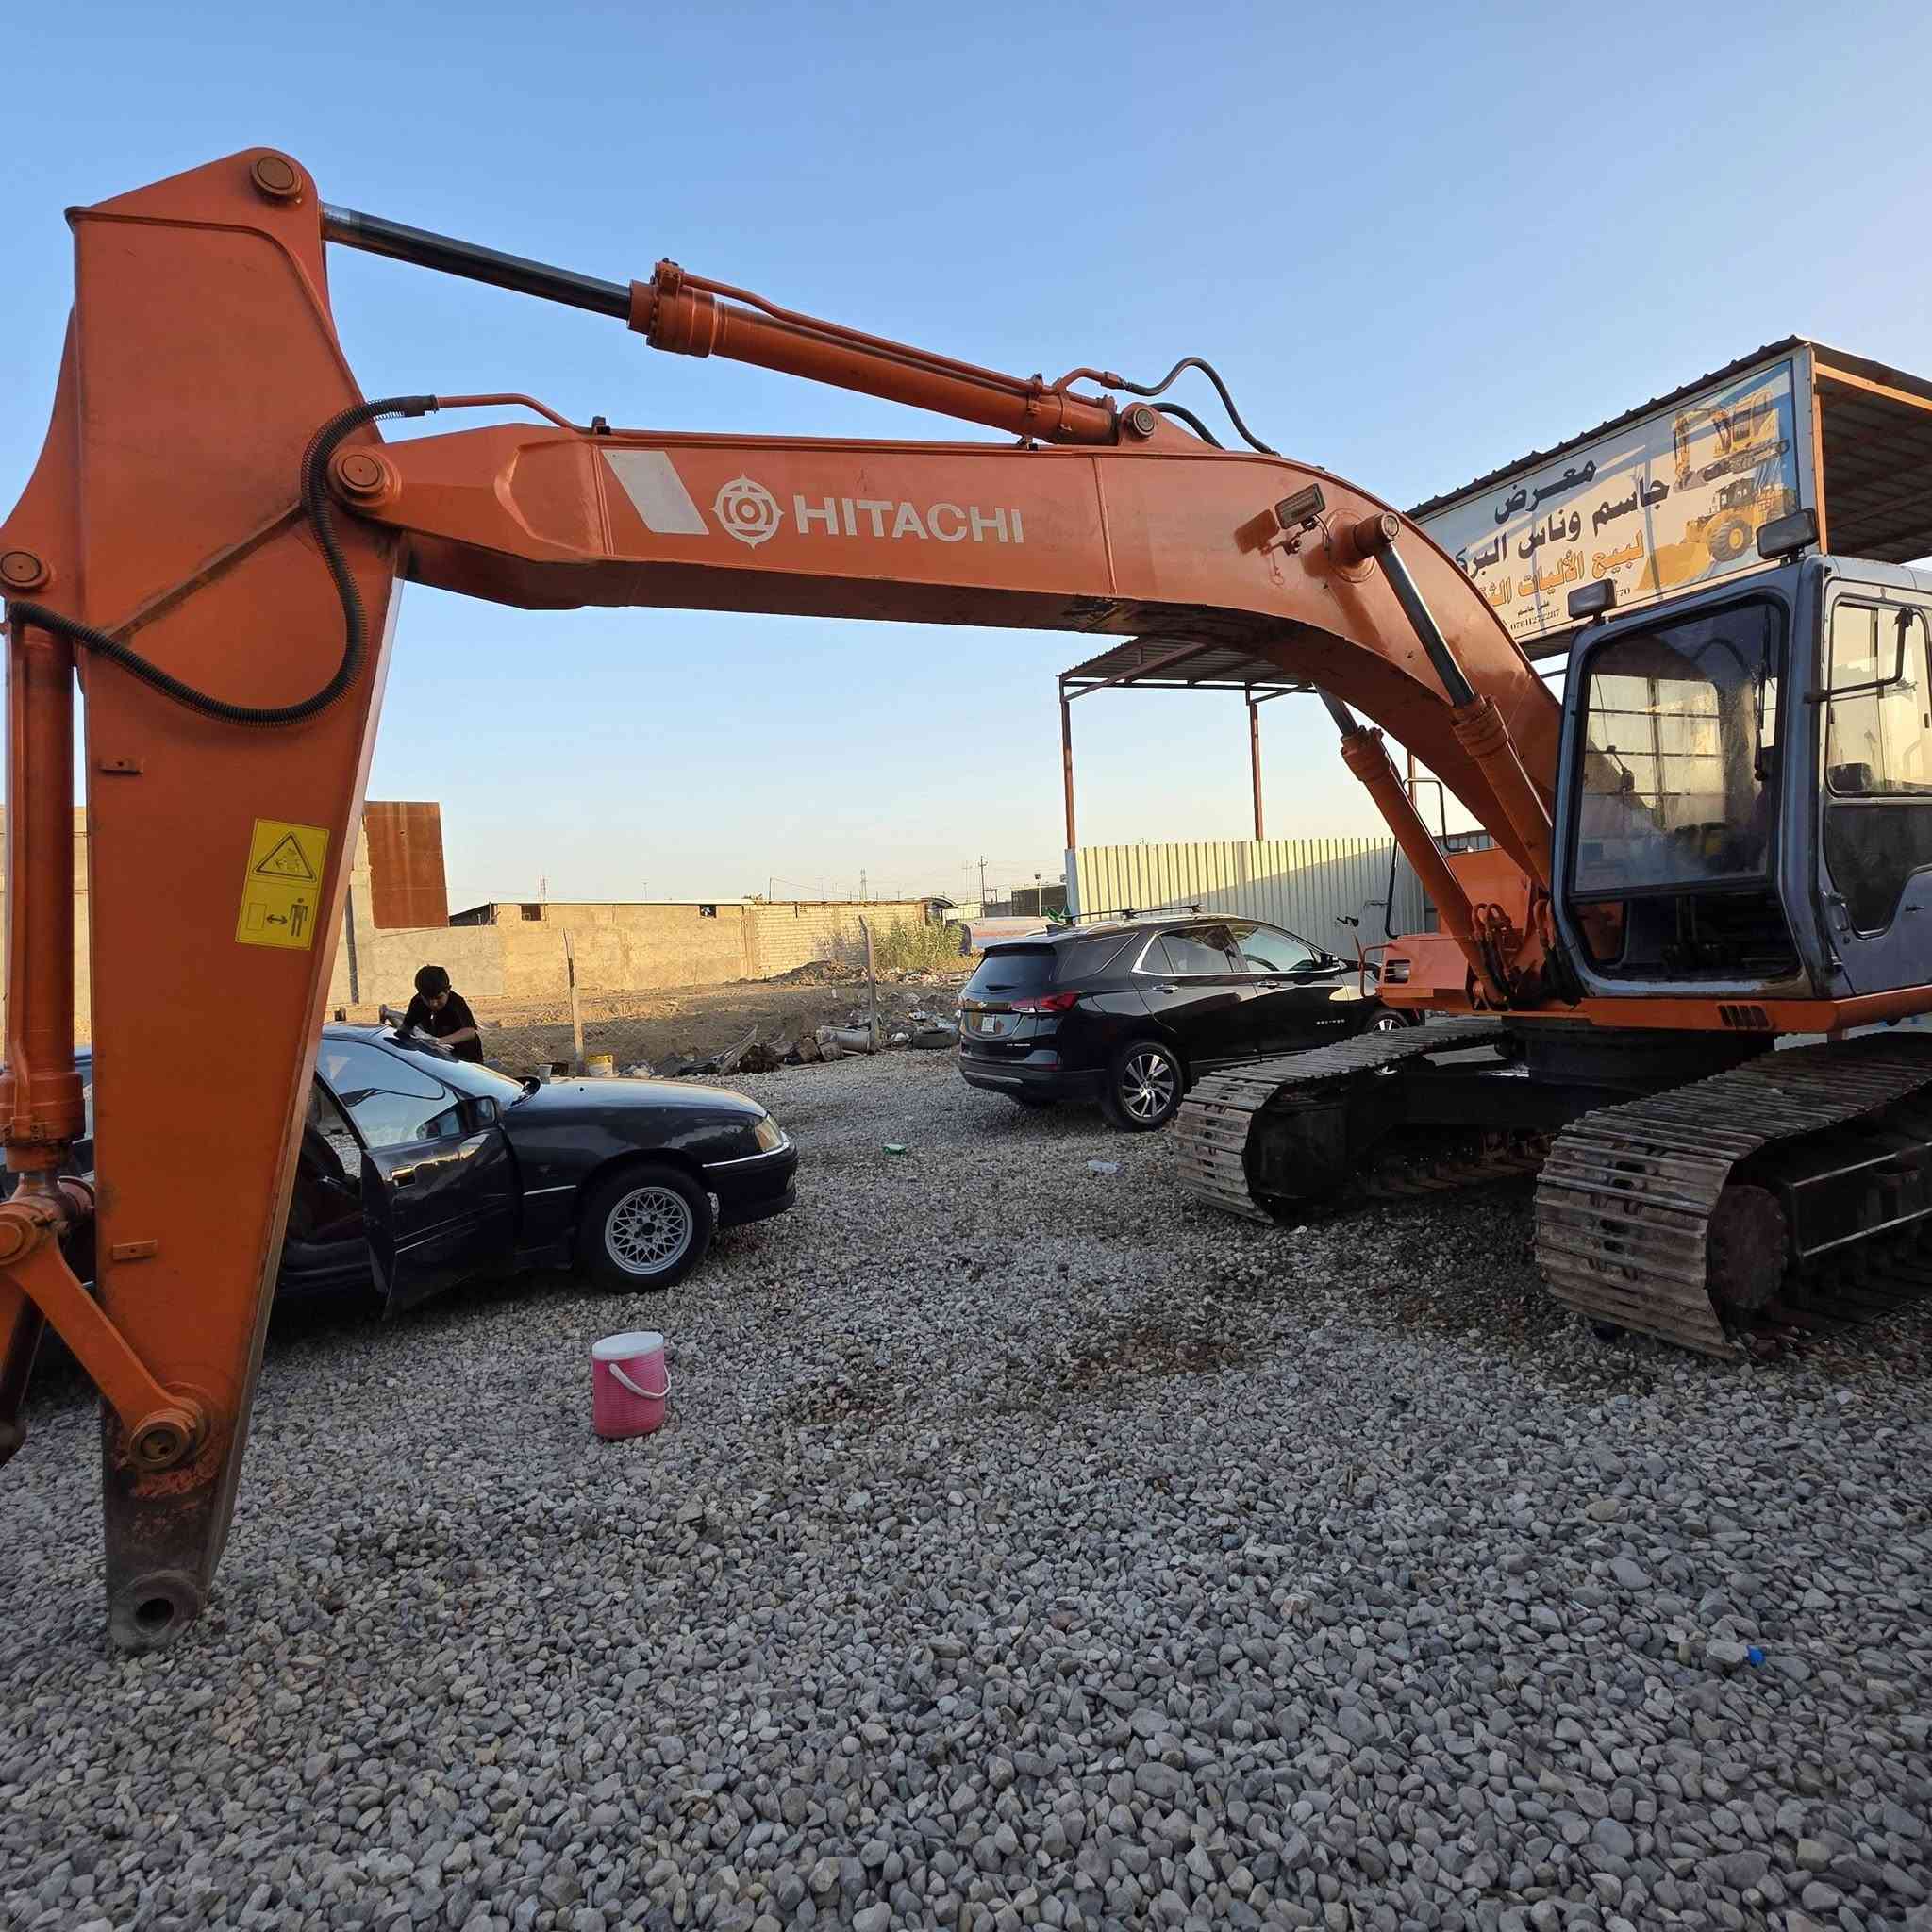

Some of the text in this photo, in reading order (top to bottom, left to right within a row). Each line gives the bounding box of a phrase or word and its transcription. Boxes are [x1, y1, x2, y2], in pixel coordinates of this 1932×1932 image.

[1495, 460, 1596, 525] معرض
[1592, 477, 1669, 537] جاسم
[793, 495, 1024, 543] HITACHI
[1518, 509, 1581, 559] وناس
[1591, 529, 1644, 579] لبيع
